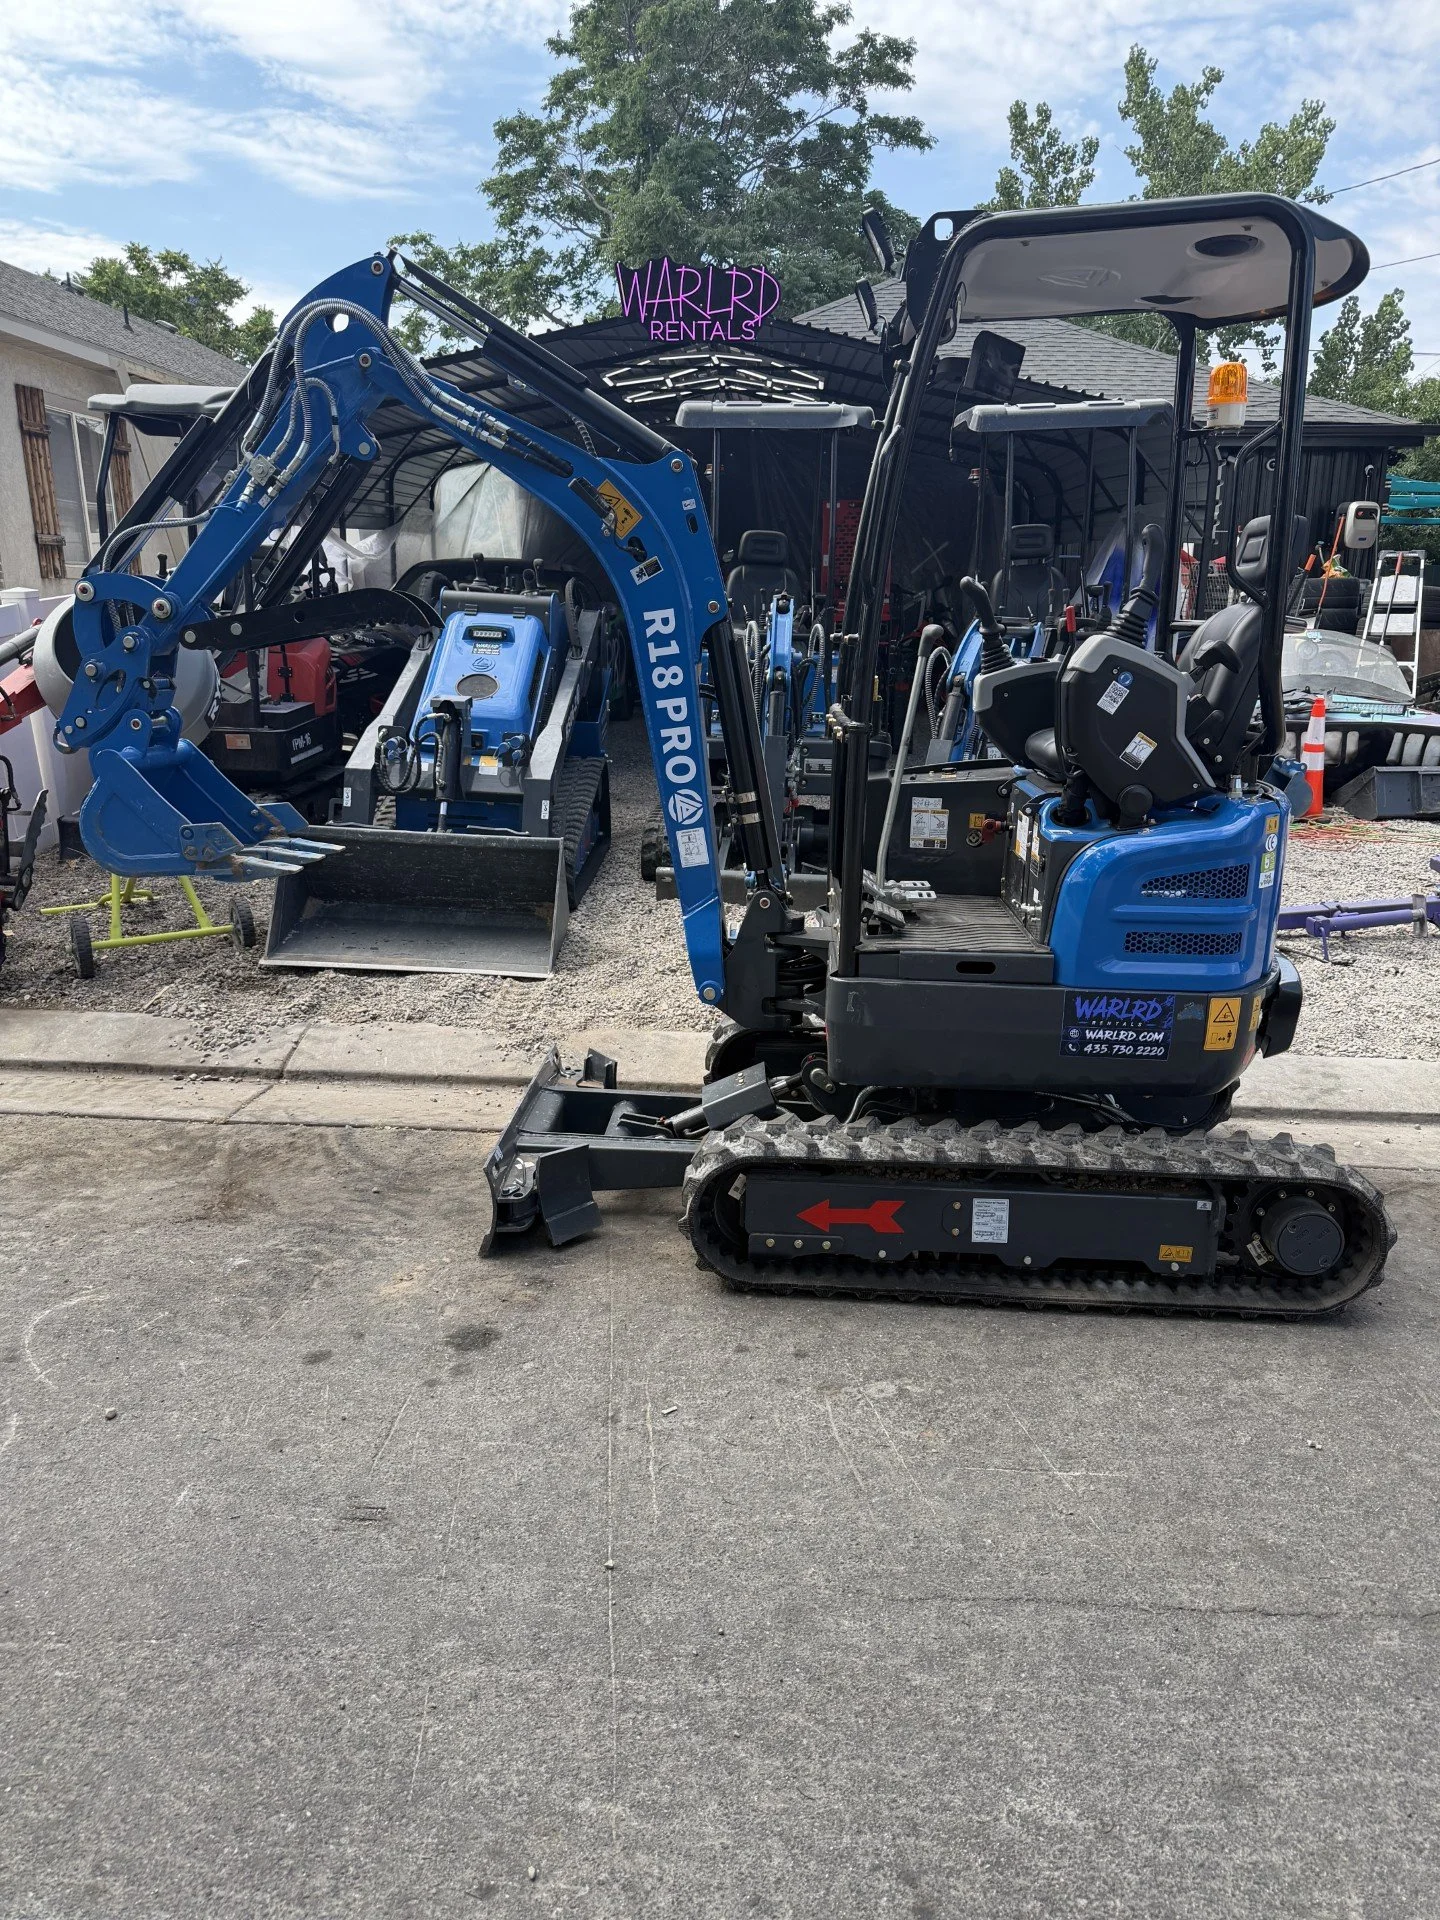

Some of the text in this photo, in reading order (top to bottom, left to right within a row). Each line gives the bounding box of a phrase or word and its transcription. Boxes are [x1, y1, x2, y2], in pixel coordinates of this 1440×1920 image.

[616, 257, 780, 327] WARLRD
[650, 320, 756, 341] RENTALS
[643, 608, 684, 689] R18
[656, 697, 697, 784] PRO
[1075, 996, 1162, 1022] WARLRD
[1085, 1029, 1165, 1043] WARLRD.COM
